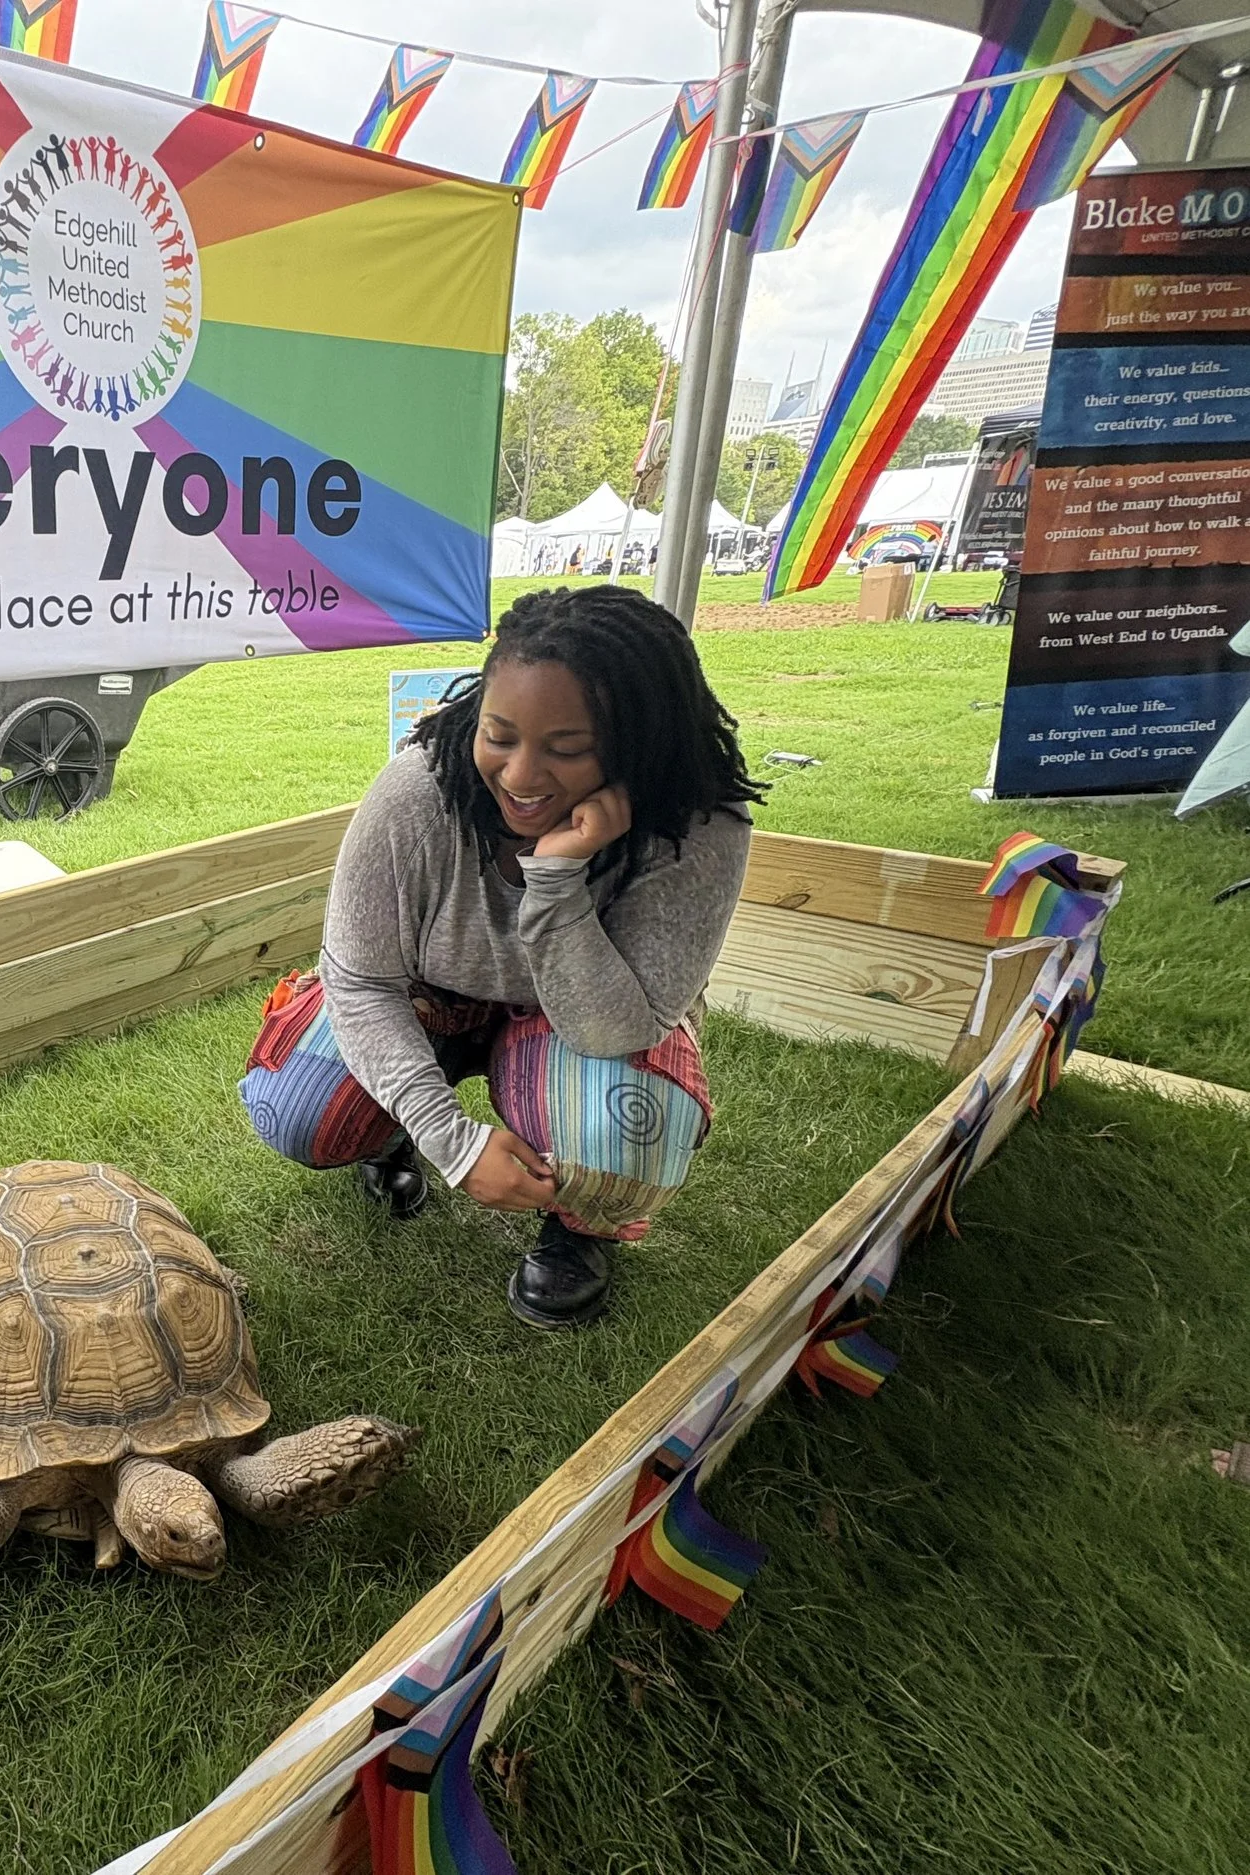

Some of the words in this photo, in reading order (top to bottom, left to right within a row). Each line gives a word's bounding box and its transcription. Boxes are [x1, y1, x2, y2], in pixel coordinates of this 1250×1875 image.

[1082, 197, 1174, 230] Blake
[54, 209, 137, 247] Edgehill
[1142, 232, 1178, 242] UNITED
[1181, 228, 1239, 240] METHODIST
[63, 246, 129, 279] United
[48, 276, 147, 313] Methodist
[1134, 284, 1156, 297] We
[1162, 282, 1201, 295] value
[63, 312, 133, 343] Church
[1105, 312, 1134, 328] just
[1140, 310, 1160, 323] the
[1166, 311, 1196, 323] way
[1201, 309, 1226, 321] you
[1119, 366, 1141, 378] We
[1146, 364, 1186, 377] value
[1084, 393, 1119, 407] their
[1123, 391, 1177, 405] energy,
[1094, 416, 1167, 431] creativity,
[1173, 413, 1199, 426] and
[1203, 412, 1237, 424] love.
[1045, 479, 1067, 491] We
[1073, 477, 1111, 489] value
[1116, 477, 1123, 486] a
[1129, 471, 1164, 488] good
[1168, 467, 1250, 483] conversatio
[1065, 501, 1091, 514] and
[1097, 500, 1117, 512] the
[1122, 496, 1164, 510] many
[1169, 491, 1241, 508] thoughtful
[1045, 526, 1104, 542] opinions
[1109, 524, 1150, 536] about
[1154, 521, 1184, 533] how
[1189, 520, 1201, 530] to
[1206, 516, 1241, 529] walk
[1088, 546, 1140, 561] faithful
[1144, 545, 1202, 559] journey.
[109, 582, 153, 623] at
[167, 572, 232, 620] this
[247, 570, 340, 615] table
[1048, 612, 1071, 624] We
[1076, 610, 1113, 622] value
[1117, 609, 1142, 620] our
[1039, 637, 1073, 648] from
[1079, 633, 1113, 644] West
[1118, 630, 1147, 643] End
[1152, 630, 1165, 640] to
[1171, 626, 1228, 642] Uganda.
[1073, 705, 1095, 716] We
[1101, 702, 1138, 714] value
[1028, 732, 1043, 742] as
[1048, 727, 1106, 741] forgiven
[1111, 725, 1137, 736] and
[1142, 720, 1216, 733] reconciled
[1040, 750, 1085, 766] people
[1090, 749, 1104, 760] in
[1109, 746, 1148, 759] God's
[1153, 745, 1196, 759] grace.
